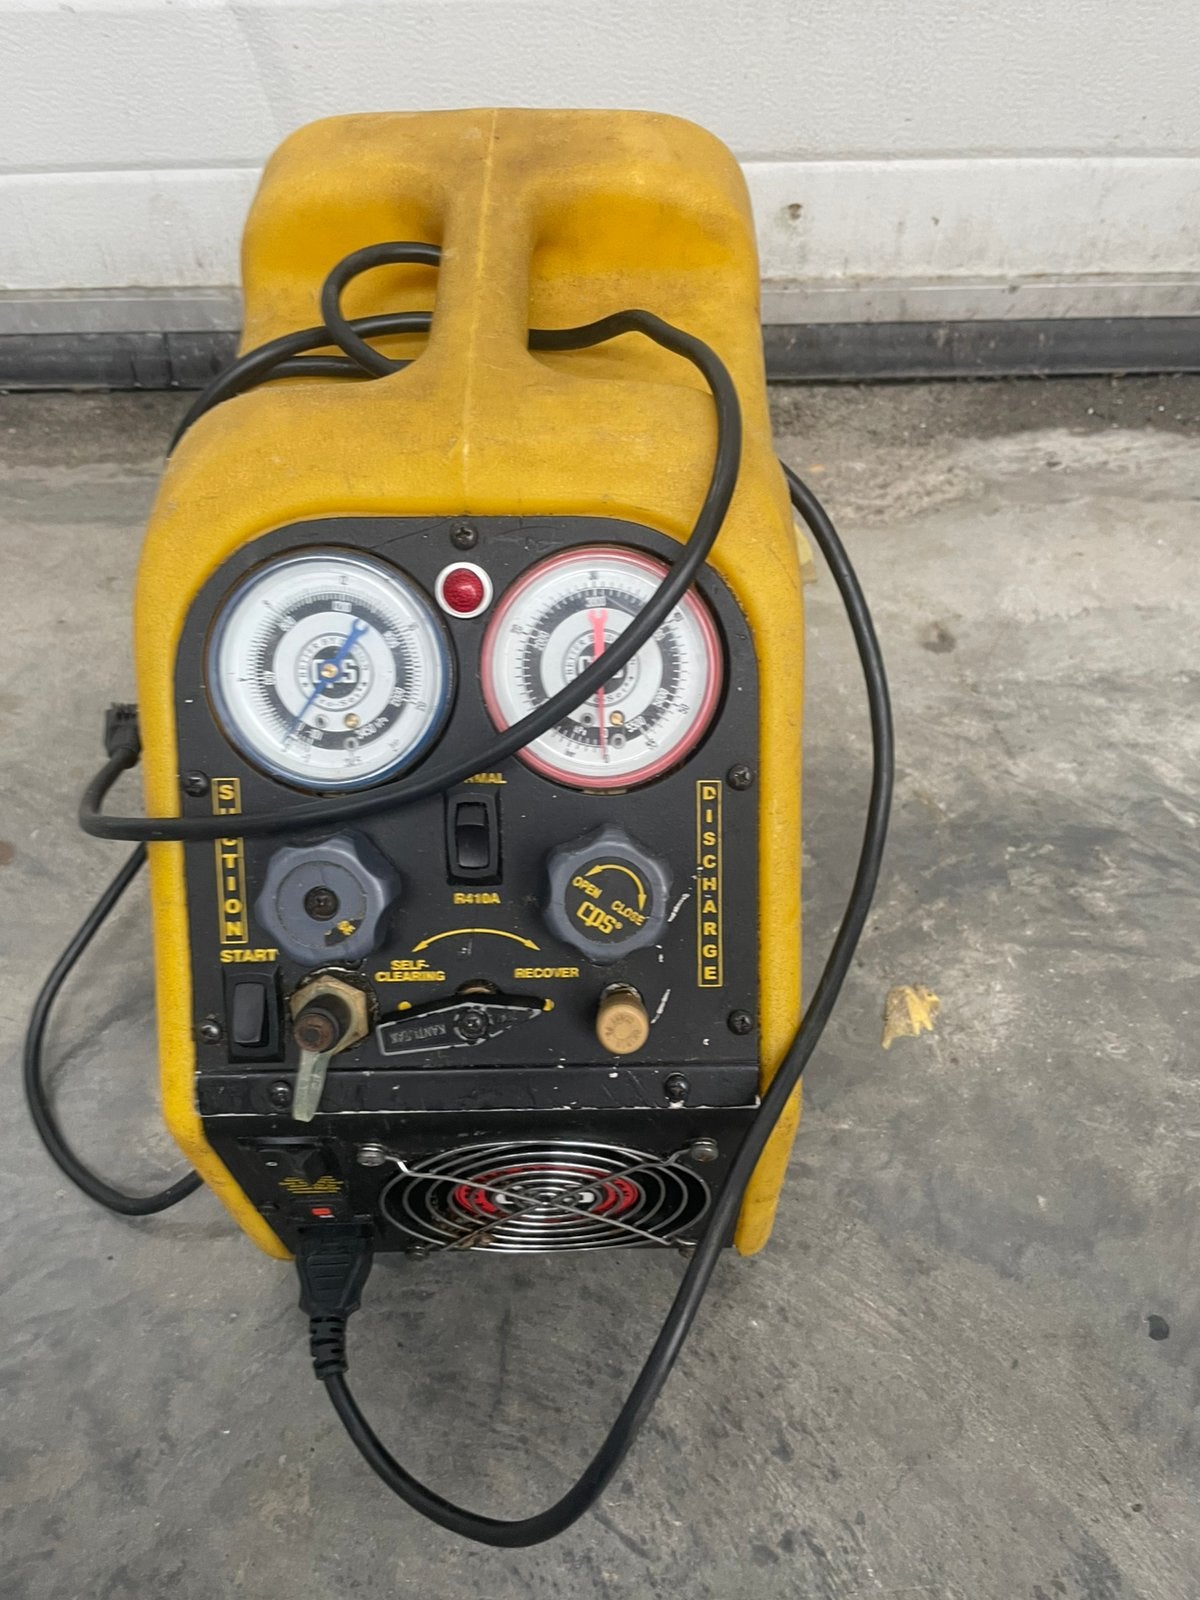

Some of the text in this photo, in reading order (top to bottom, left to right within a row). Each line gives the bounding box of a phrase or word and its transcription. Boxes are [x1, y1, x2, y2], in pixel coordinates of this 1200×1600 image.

[571, 875, 603, 900] OPEN
[702, 786, 718, 980] DISCHARGE
[453, 893, 501, 905] R410A
[610, 900, 646, 927] CLOSE
[220, 949, 278, 963] START
[390, 960, 430, 971] SELF-
[375, 971, 446, 982] CLEARING
[514, 967, 580, 979] RECOVER
